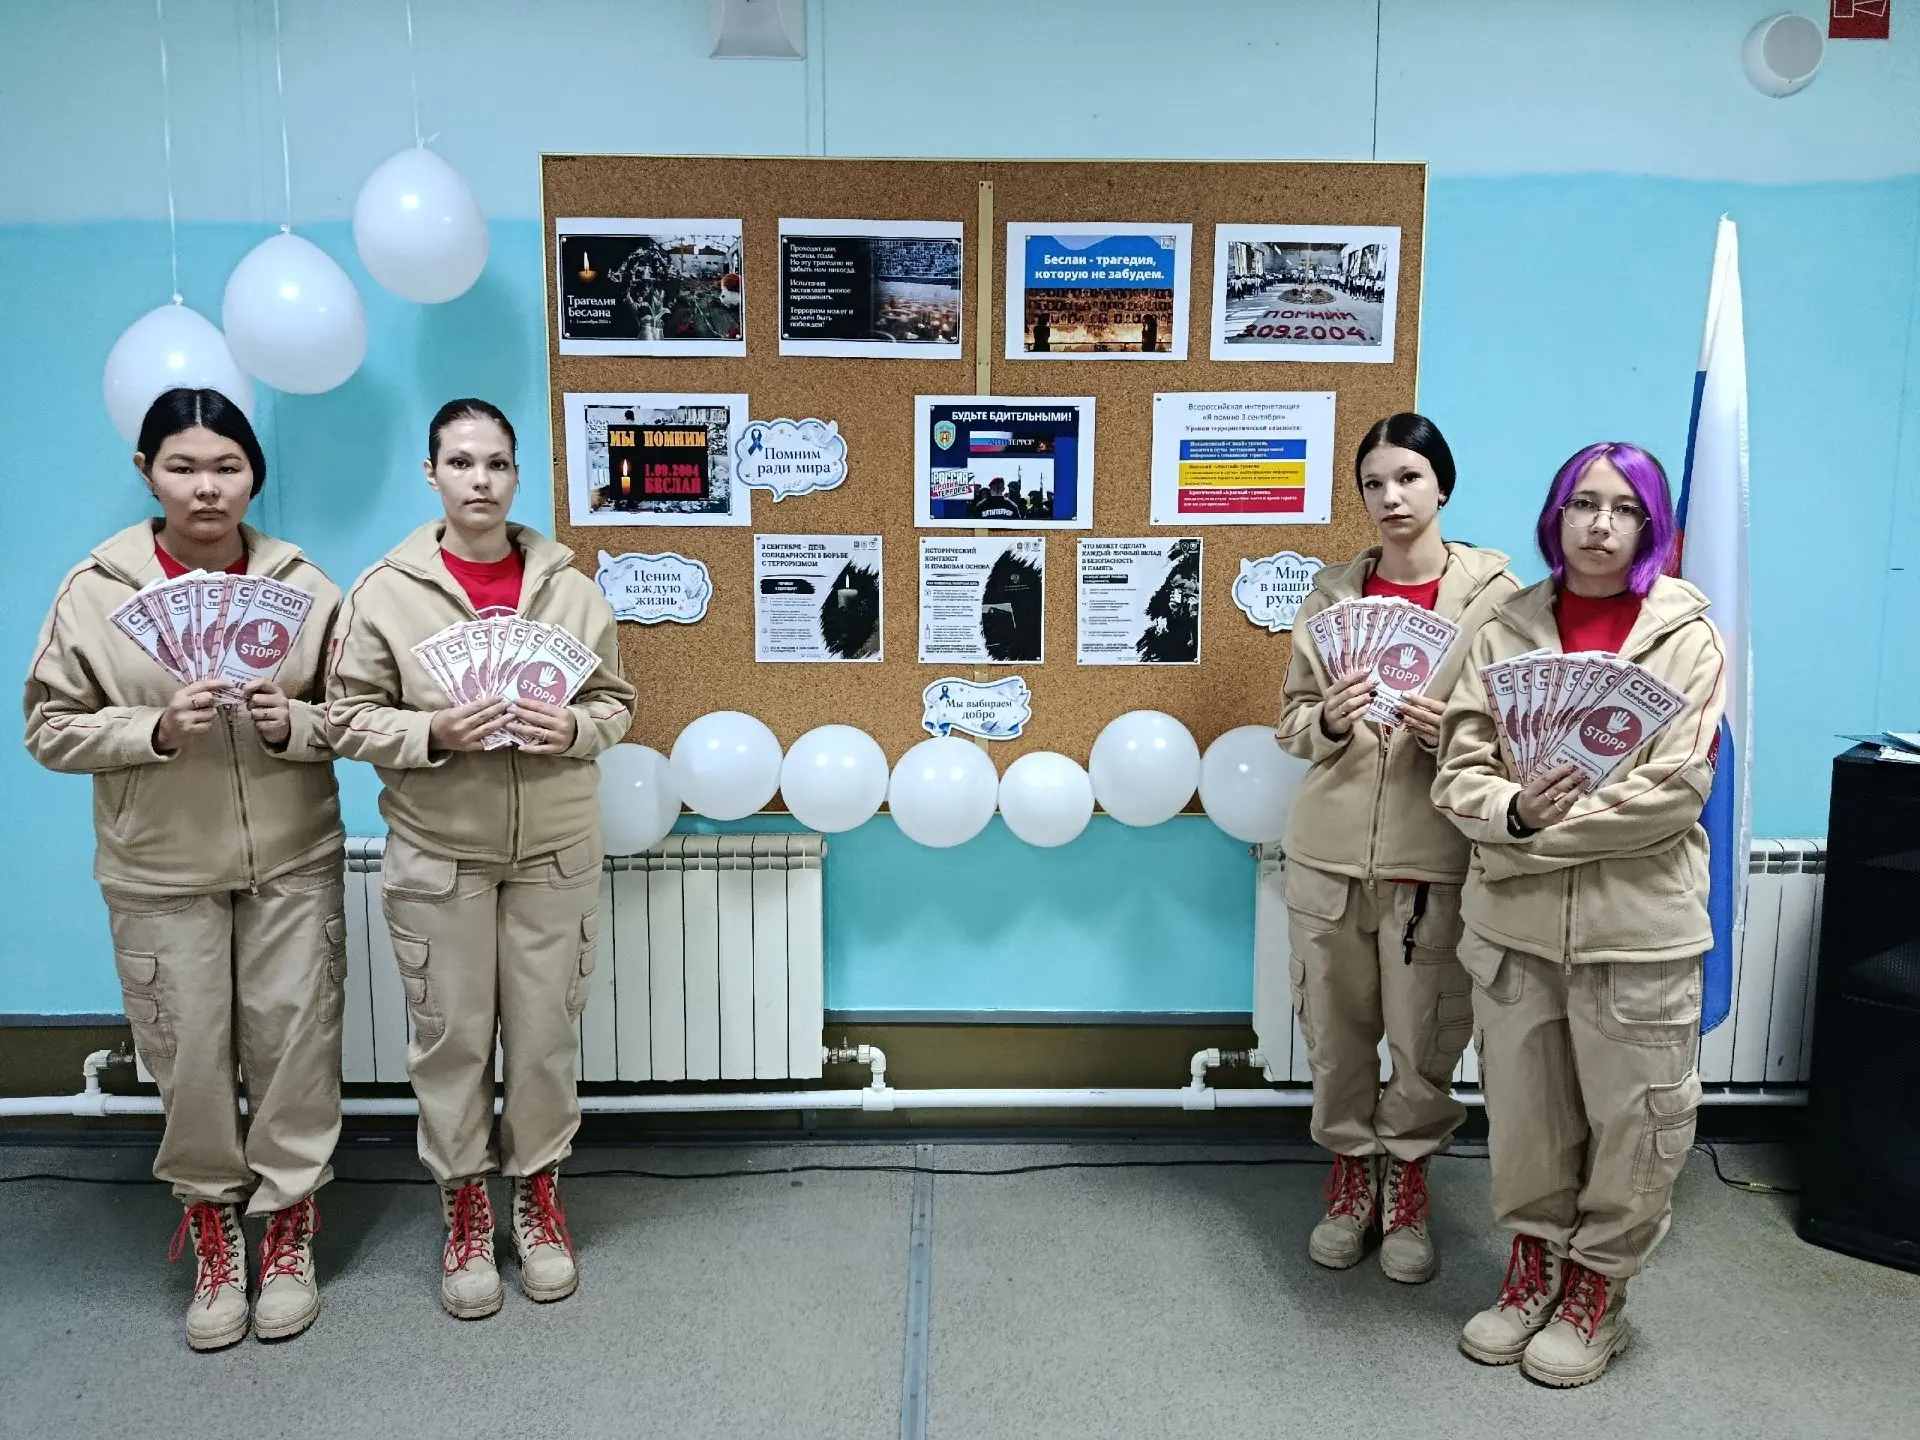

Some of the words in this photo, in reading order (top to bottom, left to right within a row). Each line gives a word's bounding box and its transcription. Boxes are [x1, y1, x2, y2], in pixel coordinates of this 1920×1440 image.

[1044, 255, 1087, 265] Беслан
[1096, 256, 1156, 267] трагедия,
[1035, 270, 1089, 281] которую
[1091, 271, 1106, 279] не
[1108, 268, 1165, 281] забудем.
[567, 295, 616, 308] Трагедия
[568, 307, 611, 317] Беслана
[1188, 403, 1243, 411] Всероссийская
[951, 411, 988, 422] БУДЬТЕ
[989, 411, 1072, 422] БДИТЕЛЬНЫМИ!
[609, 430, 636, 447] МЫ
[643, 430, 706, 447] ПОМНИМ
[765, 447, 821, 460] Помним
[757, 464, 791, 477] ради
[796, 464, 831, 476] мира
[645, 477, 702, 494] БЕСЛАН
[634, 570, 681, 583] Ценим
[1275, 566, 1309, 581] Мир
[625, 585, 681, 596] каждую
[1260, 583, 1268, 591] в
[261, 589, 304, 611] СТОП
[635, 597, 677, 605] жизнь
[1266, 594, 1305, 608] рука
[1408, 616, 1448, 640] СТОП
[240, 643, 281, 659] STOPP
[553, 637, 588, 667] СТОП
[1382, 664, 1420, 684] STOPP
[520, 679, 557, 704] STOPP
[1630, 679, 1673, 712] СТОП
[945, 699, 964, 708] Мы
[966, 699, 1012, 709] выбираем
[961, 709, 995, 721] добро
[1583, 725, 1627, 751] STOPP
